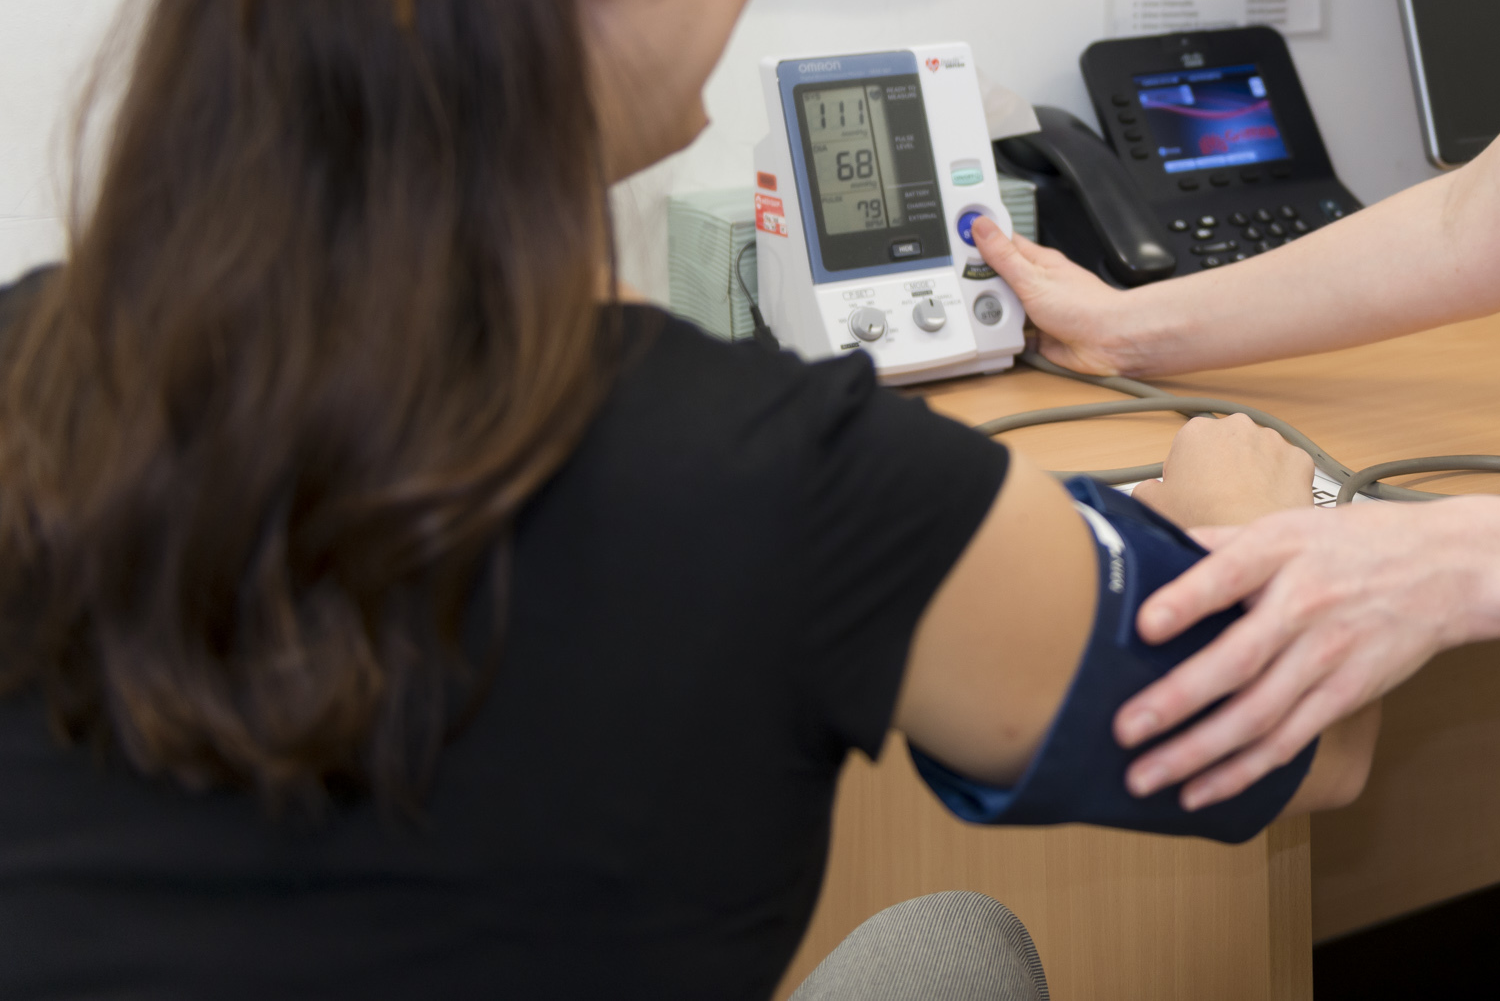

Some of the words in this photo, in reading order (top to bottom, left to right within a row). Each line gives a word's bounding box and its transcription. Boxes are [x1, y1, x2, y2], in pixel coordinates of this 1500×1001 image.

[798, 60, 842, 74] OMRON
[886, 86, 906, 94] READY
[907, 84, 917, 92] TO
[887, 92, 917, 101] MEASURE
[820, 99, 864, 130] 111
[895, 143, 915, 151] LEVEL
[836, 148, 874, 182] 68
[904, 189, 930, 198] BATTERY
[857, 198, 882, 219] 79
[906, 201, 936, 210] CHARGING
[908, 213, 938, 222] EXTERNAL
[898, 243, 914, 253] HIDE
[909, 280, 929, 290] MODE
[981, 310, 1001, 320] STOP
